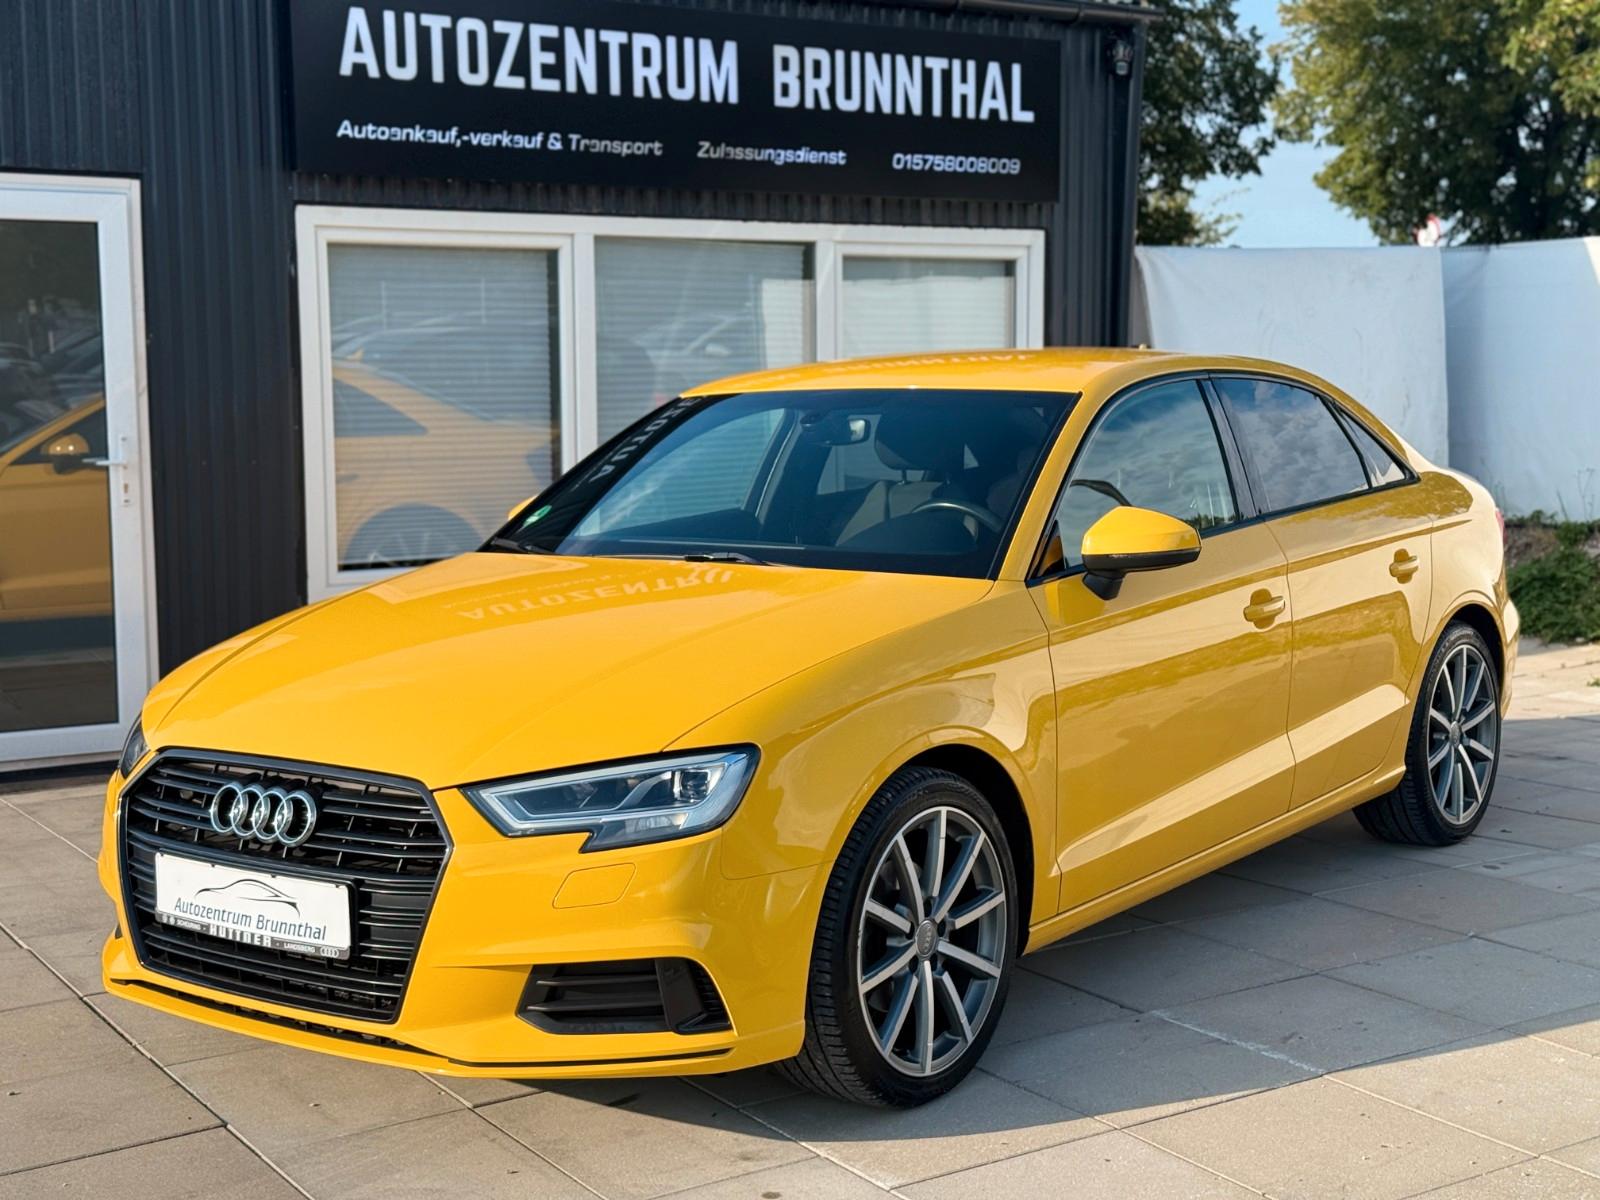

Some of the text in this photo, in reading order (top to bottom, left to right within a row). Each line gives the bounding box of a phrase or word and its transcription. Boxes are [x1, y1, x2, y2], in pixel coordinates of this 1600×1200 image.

[339, 6, 1035, 124] AUTOZENTRUM BRUNNTHAL
[336, 119, 663, 157] Autoankauf,-verkauf & Transport
[697, 140, 847, 166] Zulassungsdienst
[892, 152, 1021, 175] 015758008009
[174, 897, 252, 928] Autozentrum
[256, 914, 327, 941] Brunnthal
